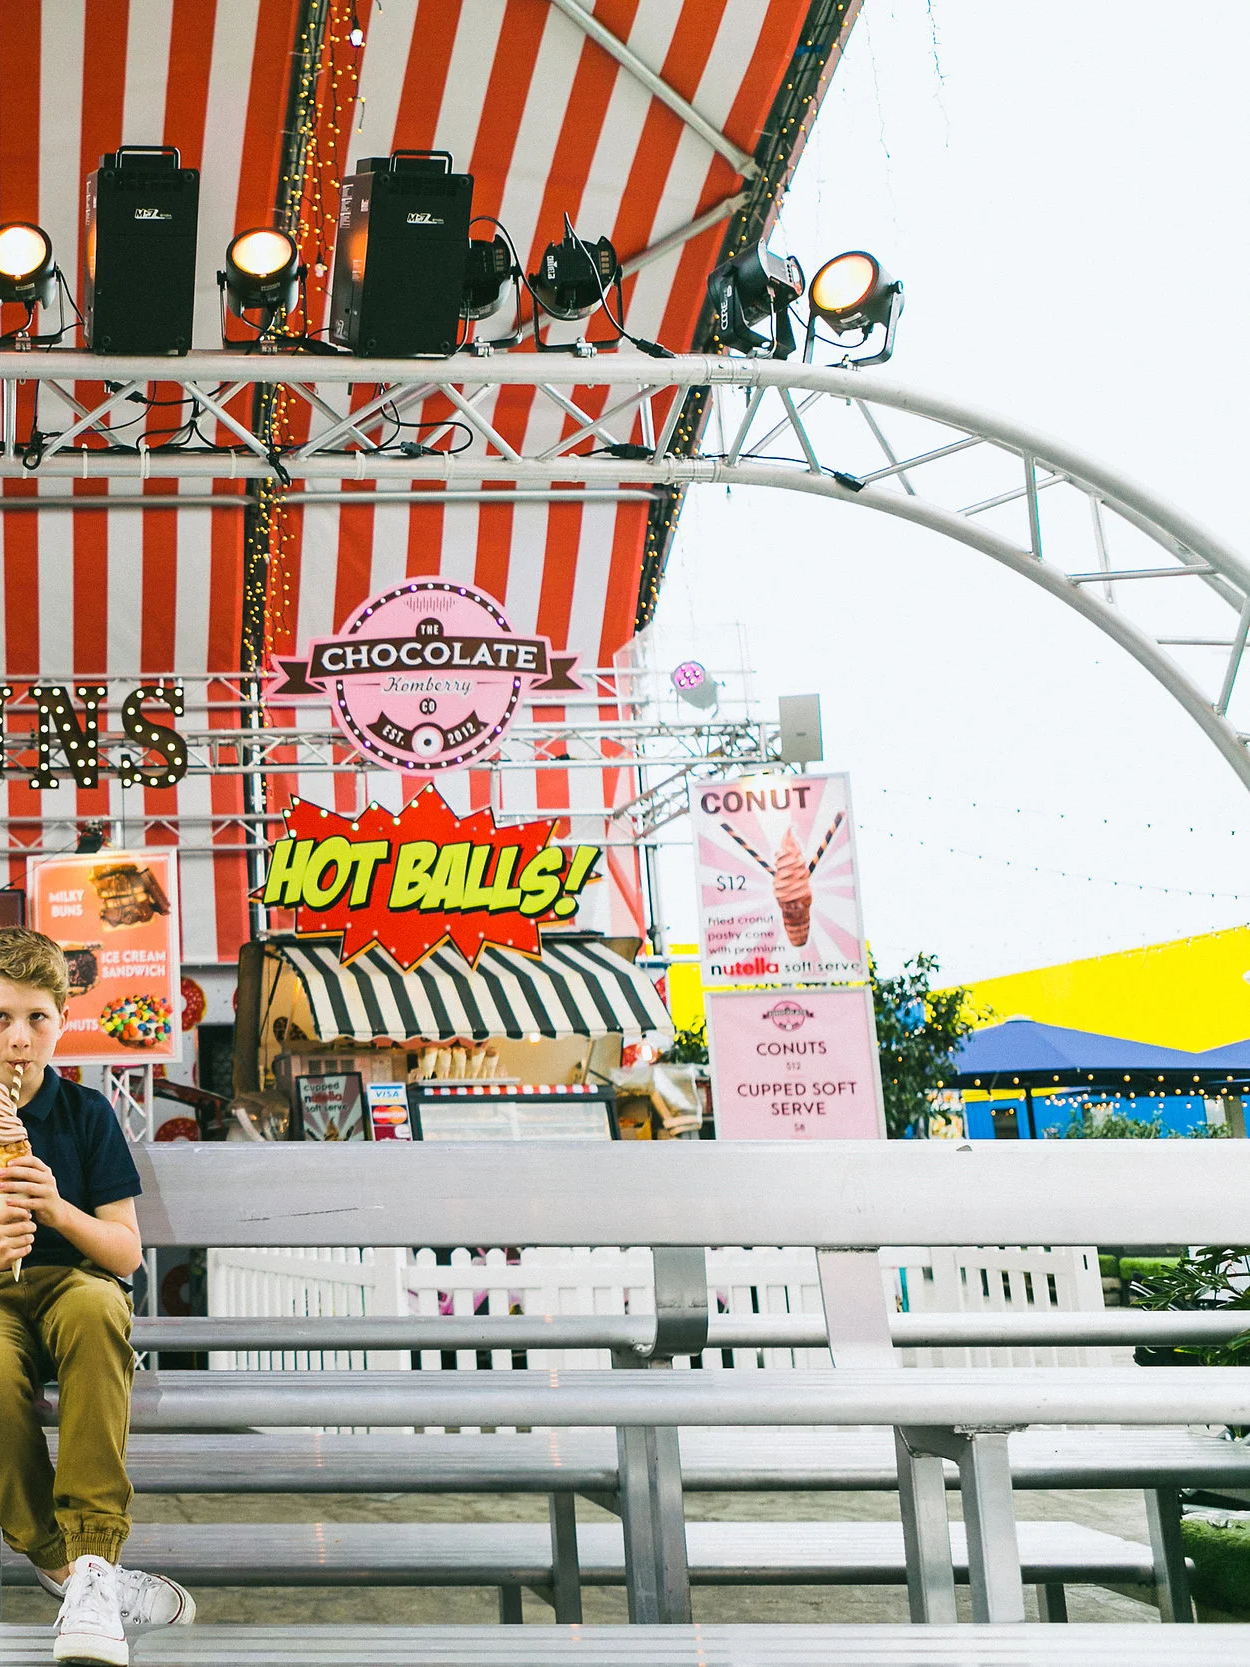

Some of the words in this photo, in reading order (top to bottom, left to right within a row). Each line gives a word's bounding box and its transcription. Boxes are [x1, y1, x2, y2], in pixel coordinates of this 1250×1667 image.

[420, 624, 439, 636] THE
[321, 642, 538, 672] CHOCOLATE
[383, 676, 474, 697] Komberry
[421, 701, 437, 713] CO
[382, 726, 405, 746] EST.
[447, 721, 477, 746] 2012
[700, 787, 811, 815] CONUT
[262, 835, 390, 909] HOT
[389, 840, 602, 918] BALLS!
[716, 875, 747, 892] $12
[49, 889, 85, 903] MILKY
[52, 904, 83, 917] BUNS
[708, 916, 734, 926] fried
[737, 915, 774, 925] cronut
[708, 931, 742, 941] pastry
[745, 931, 775, 939] cone
[101, 951, 119, 964] ICE
[124, 950, 166, 963] CREAM
[709, 945, 732, 955] with
[734, 945, 786, 956] premium
[102, 966, 166, 979] SANDWICH
[711, 957, 779, 976] nutella
[785, 961, 811, 973] soft
[817, 961, 861, 972] serve
[756, 1041, 827, 1056] CONUTS
[303, 1082, 339, 1092] cupped
[737, 1083, 806, 1097] CUPPED
[813, 1082, 857, 1096] SOFT
[306, 1103, 322, 1113] soft
[771, 1102, 827, 1116] SERVE
